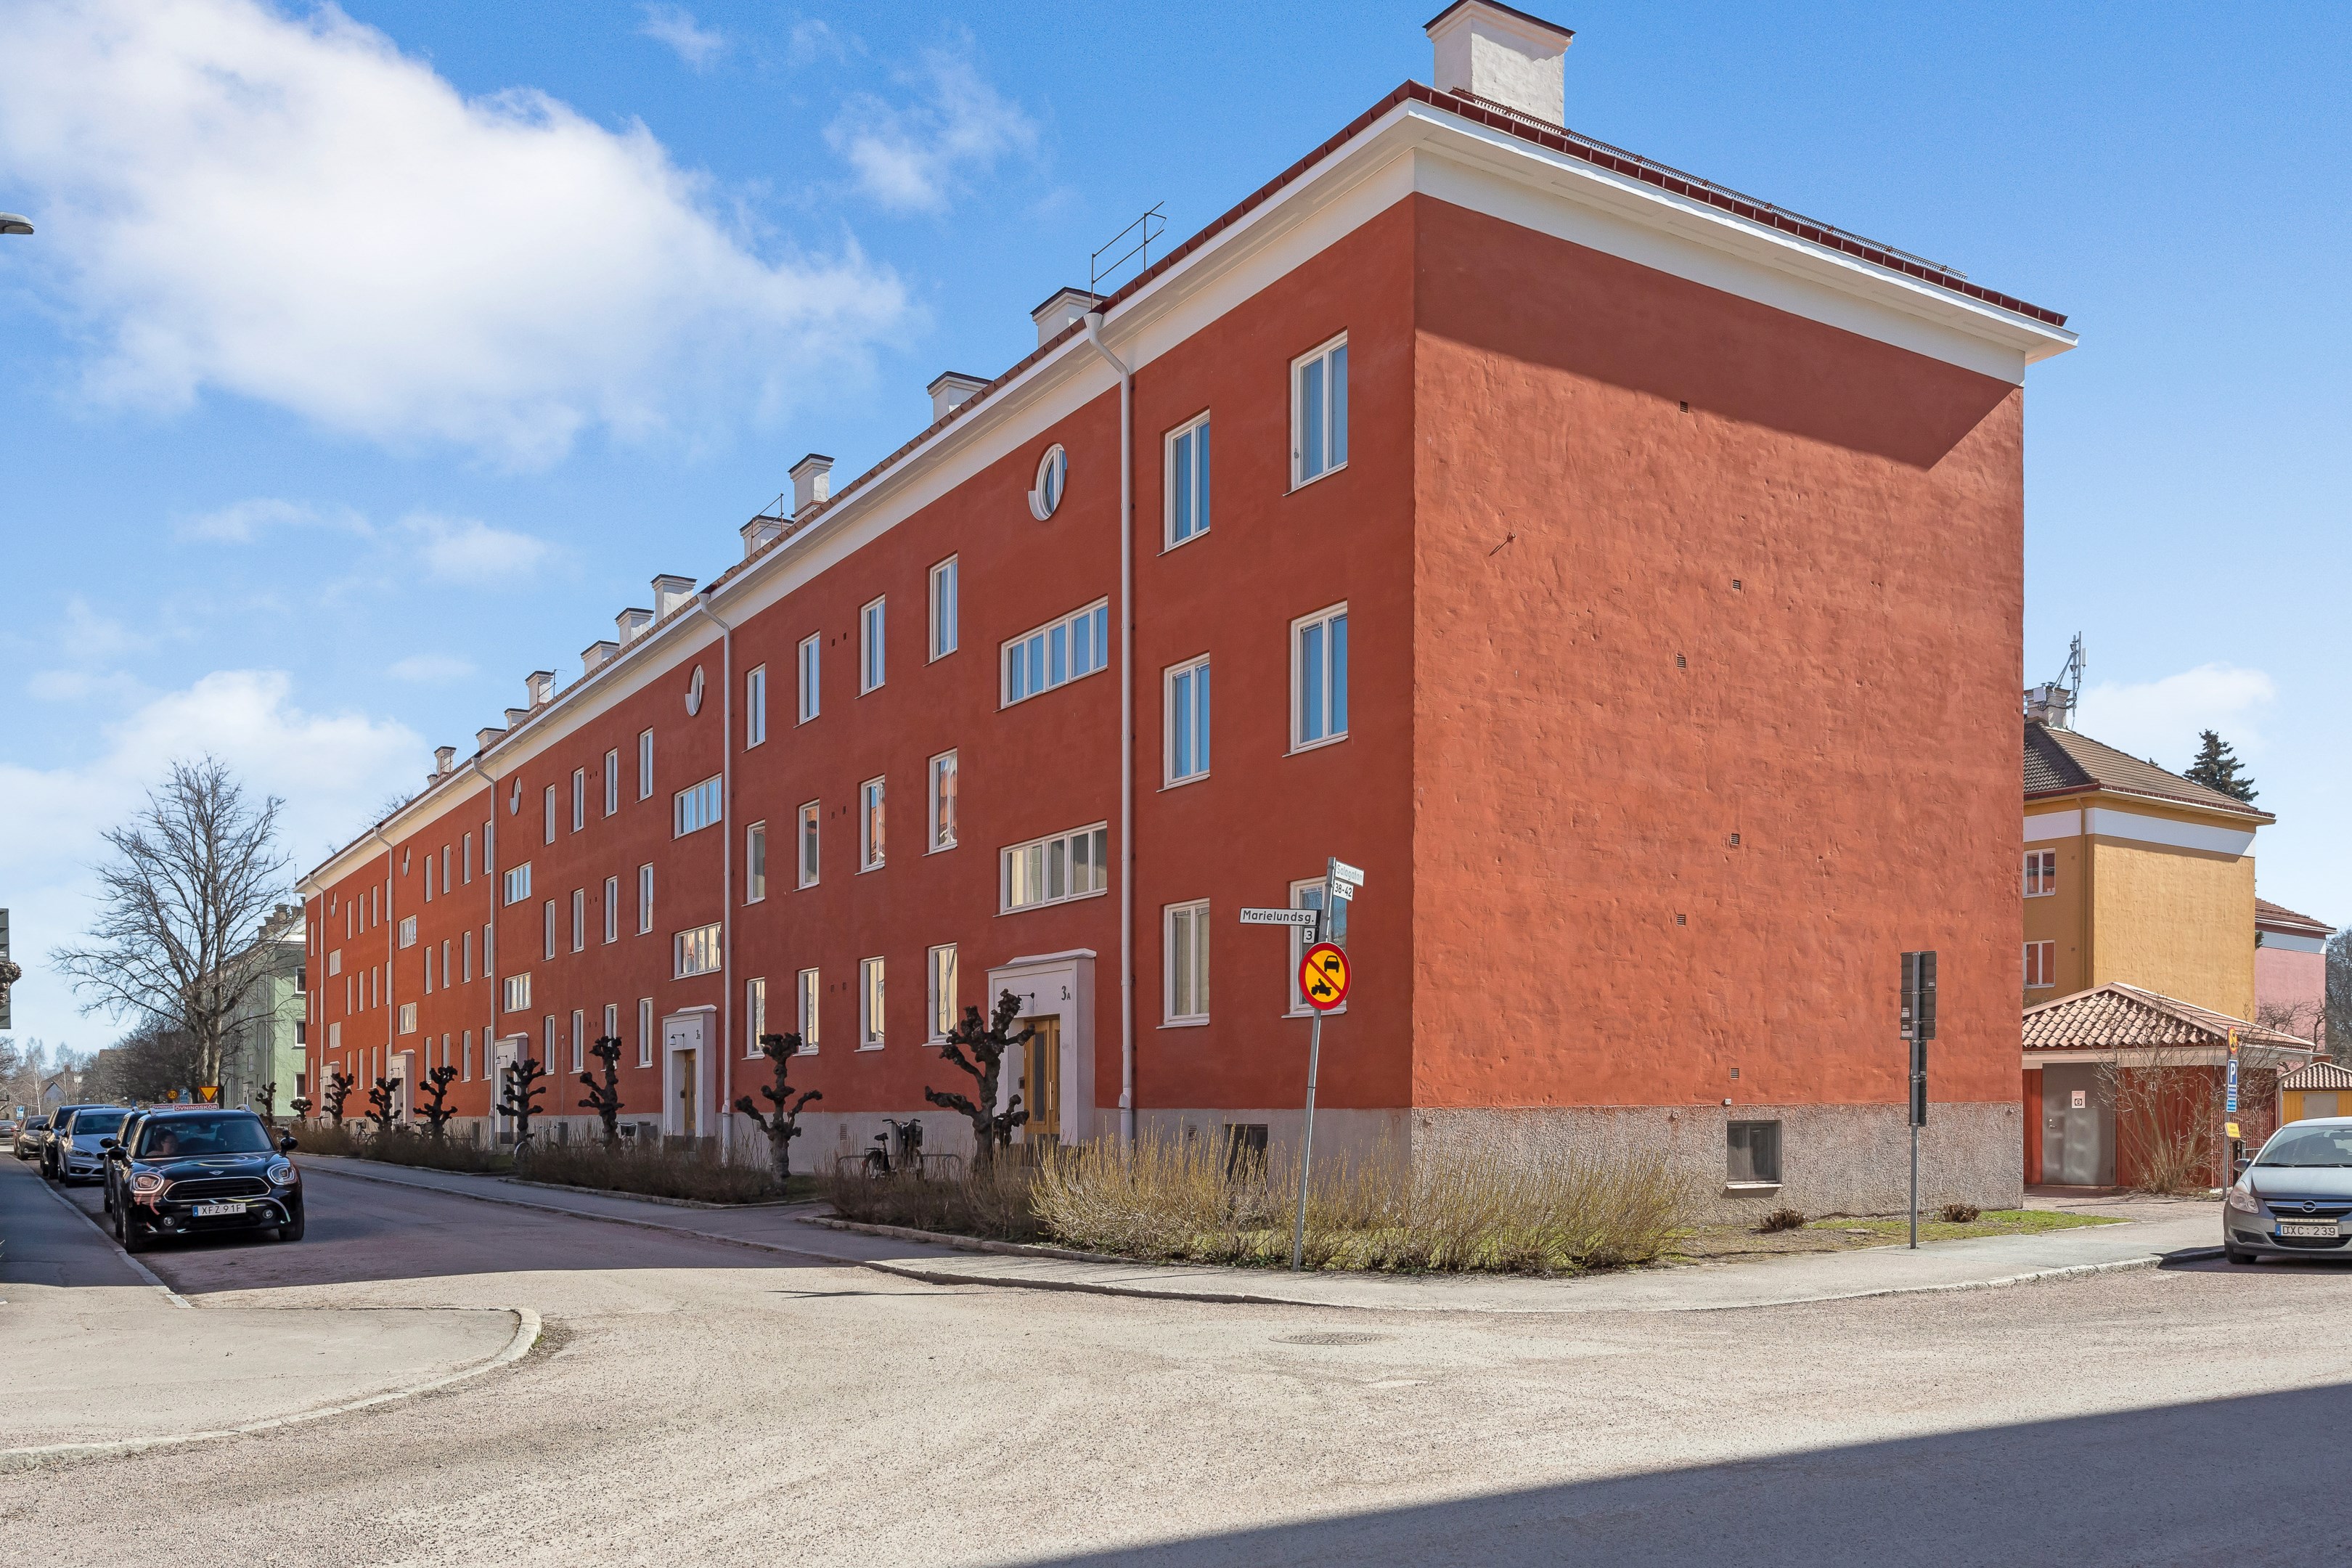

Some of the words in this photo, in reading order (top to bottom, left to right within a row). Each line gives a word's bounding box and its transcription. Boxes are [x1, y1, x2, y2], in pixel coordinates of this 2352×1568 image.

[1336, 864, 1363, 882] Salagatan
[1334, 883, 1352, 897] 38-42
[1242, 910, 1315, 924] Marielundsg.
[1305, 930, 1312, 941] 3
[2229, 1062, 2236, 1084] P
[202, 1206, 221, 1214] XFZ
[223, 1204, 242, 1213] 91F
[2282, 1225, 2304, 1236] DXC
[2313, 1226, 2336, 1236] 239
